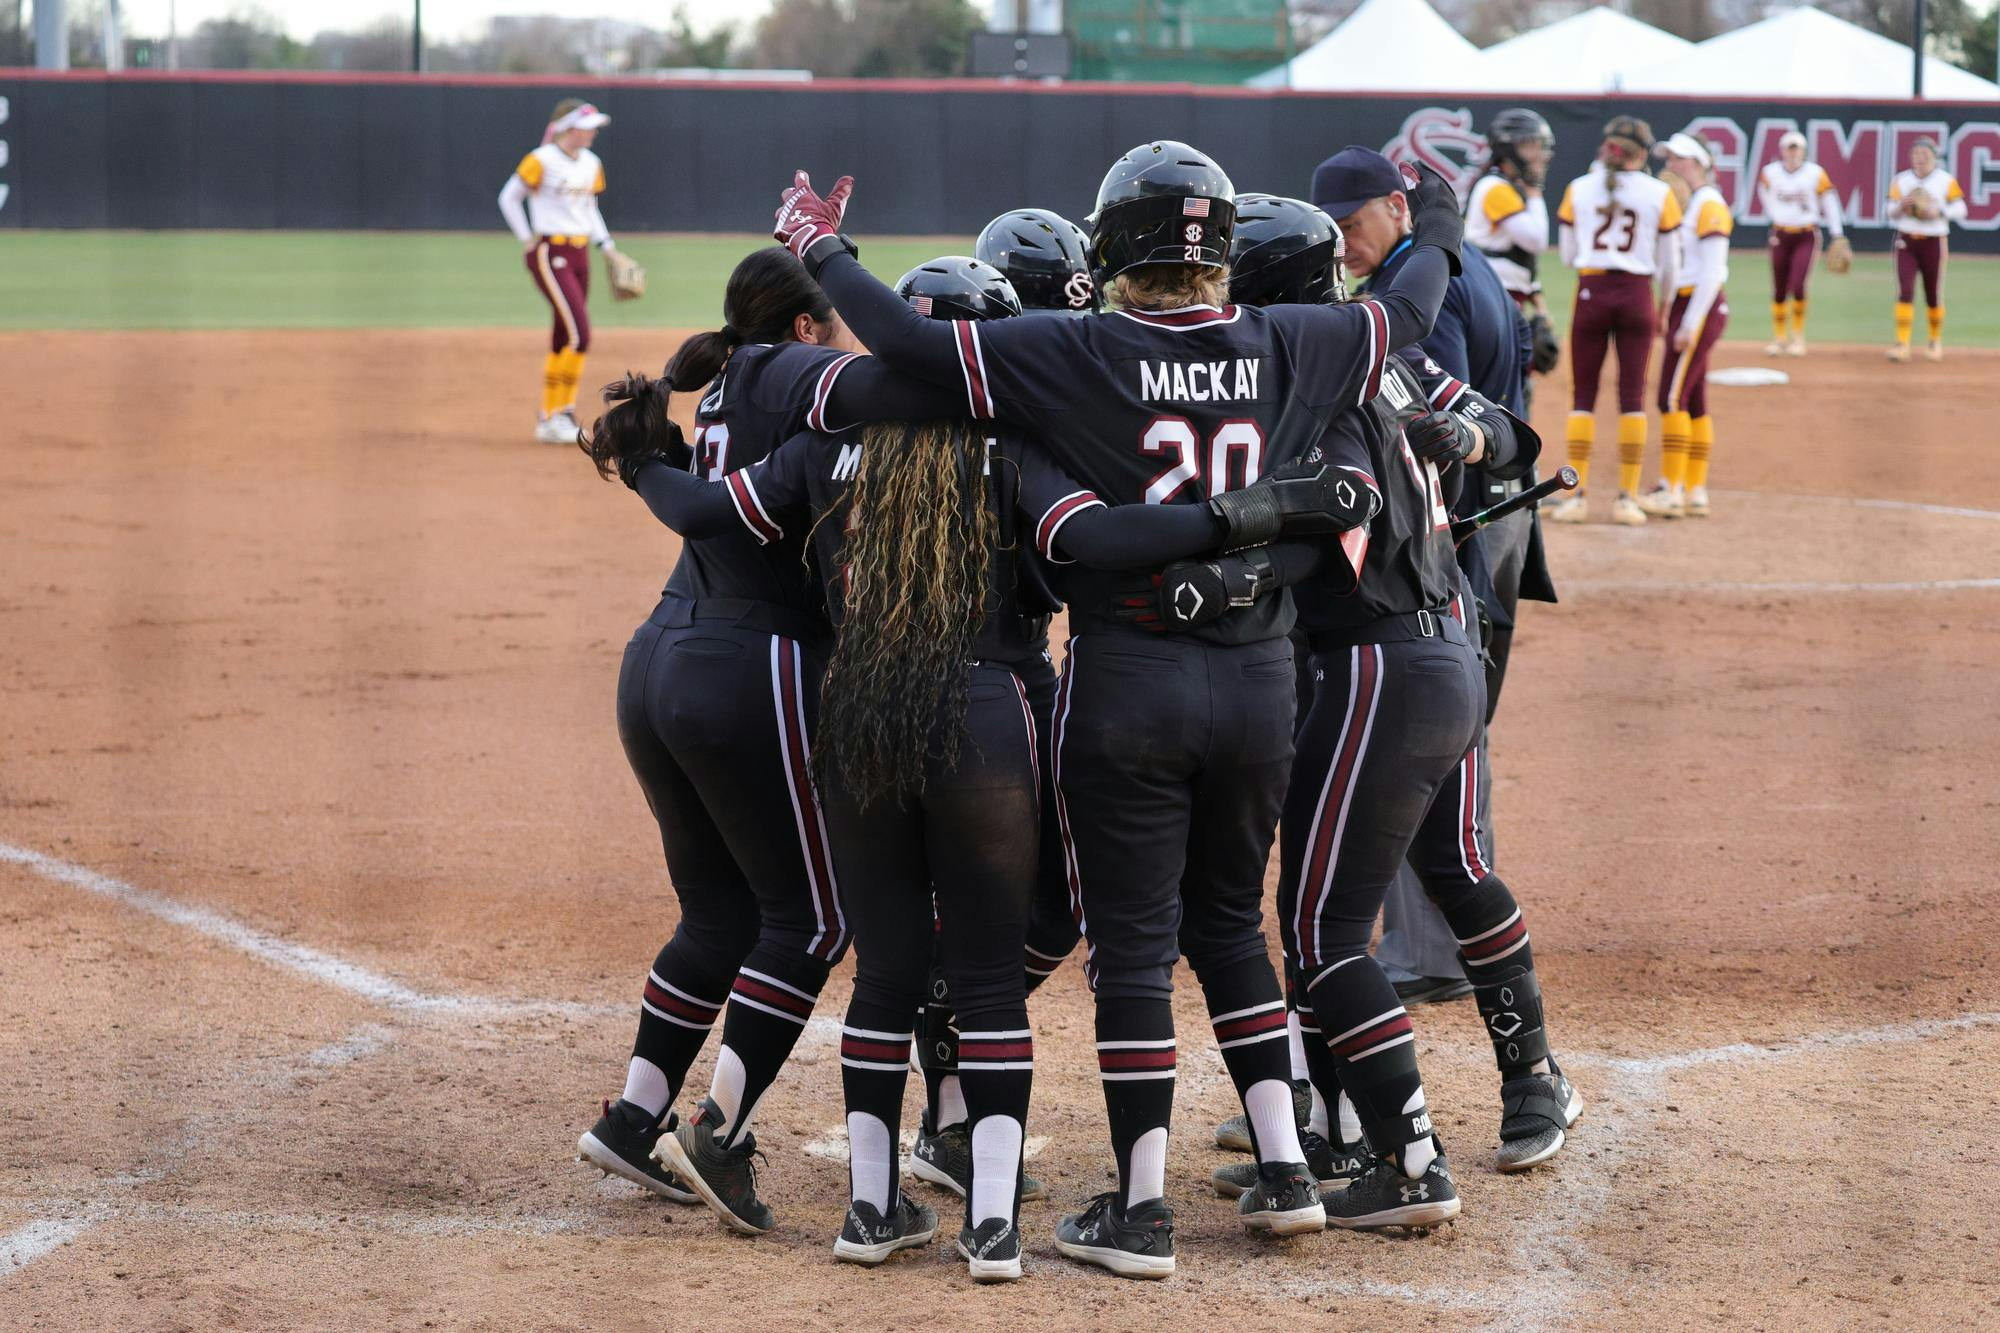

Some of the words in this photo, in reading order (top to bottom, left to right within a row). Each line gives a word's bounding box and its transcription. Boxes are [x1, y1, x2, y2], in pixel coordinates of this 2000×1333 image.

[1592, 206, 1636, 252] 23
[1184, 245, 1201, 261] 20
[1139, 358, 1260, 402] MACKAY
[1139, 416, 1265, 505] 20
[1331, 1157, 1361, 1174] UA
[875, 1225, 894, 1238] UA
